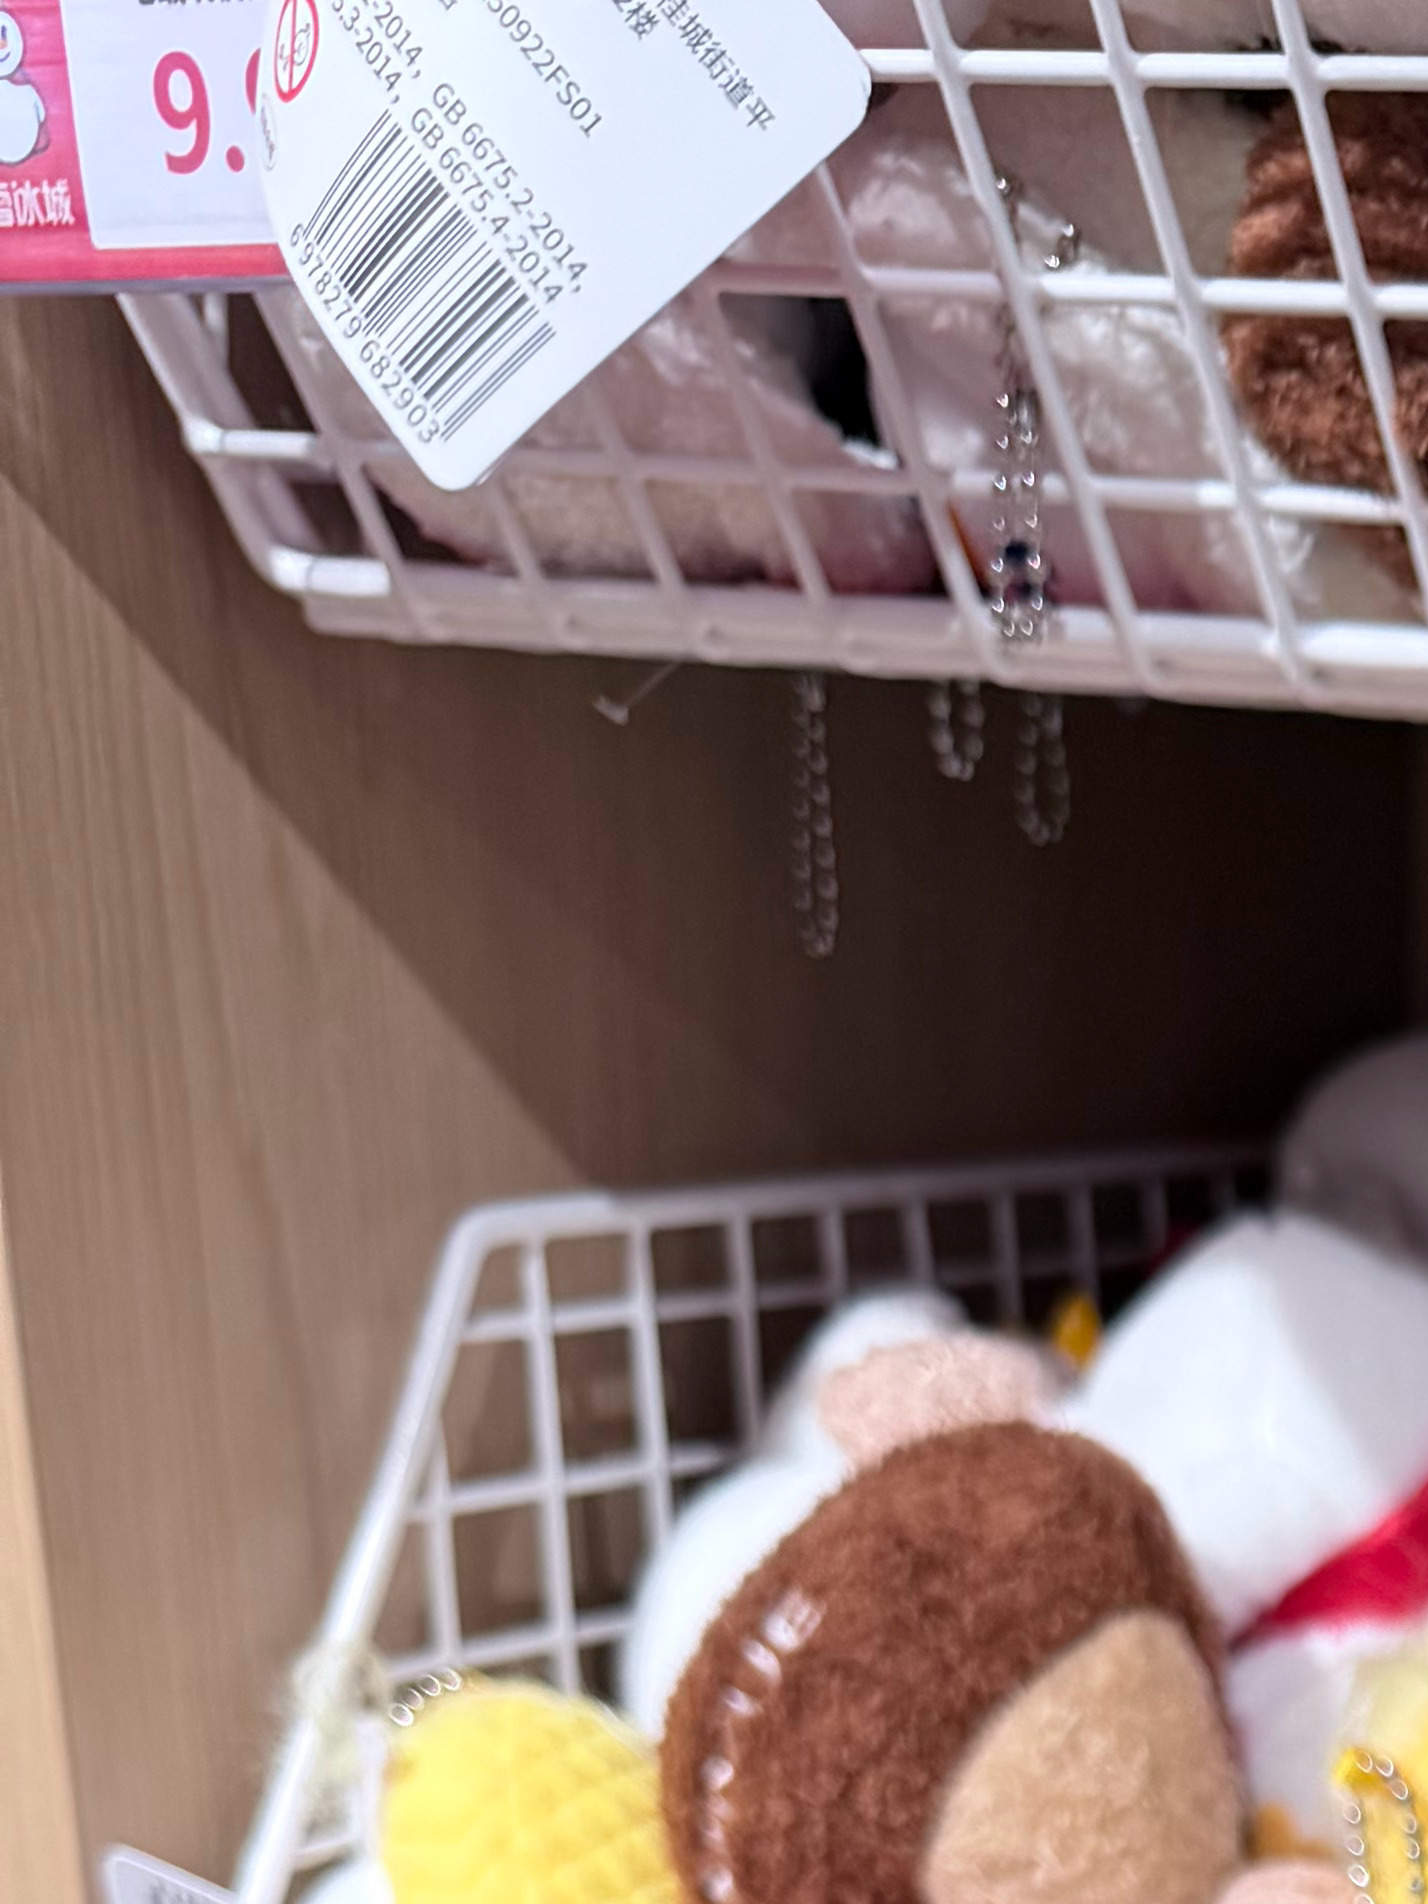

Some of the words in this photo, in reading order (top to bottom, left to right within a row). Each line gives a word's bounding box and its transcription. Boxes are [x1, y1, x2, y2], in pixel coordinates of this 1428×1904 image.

[154, 48, 261, 174] 9.
[428, 83, 468, 125] GB
[405, 107, 446, 150] GB
[435, 146, 565, 304] 6675.4-2014
[357, 338, 445, 445] 682903
